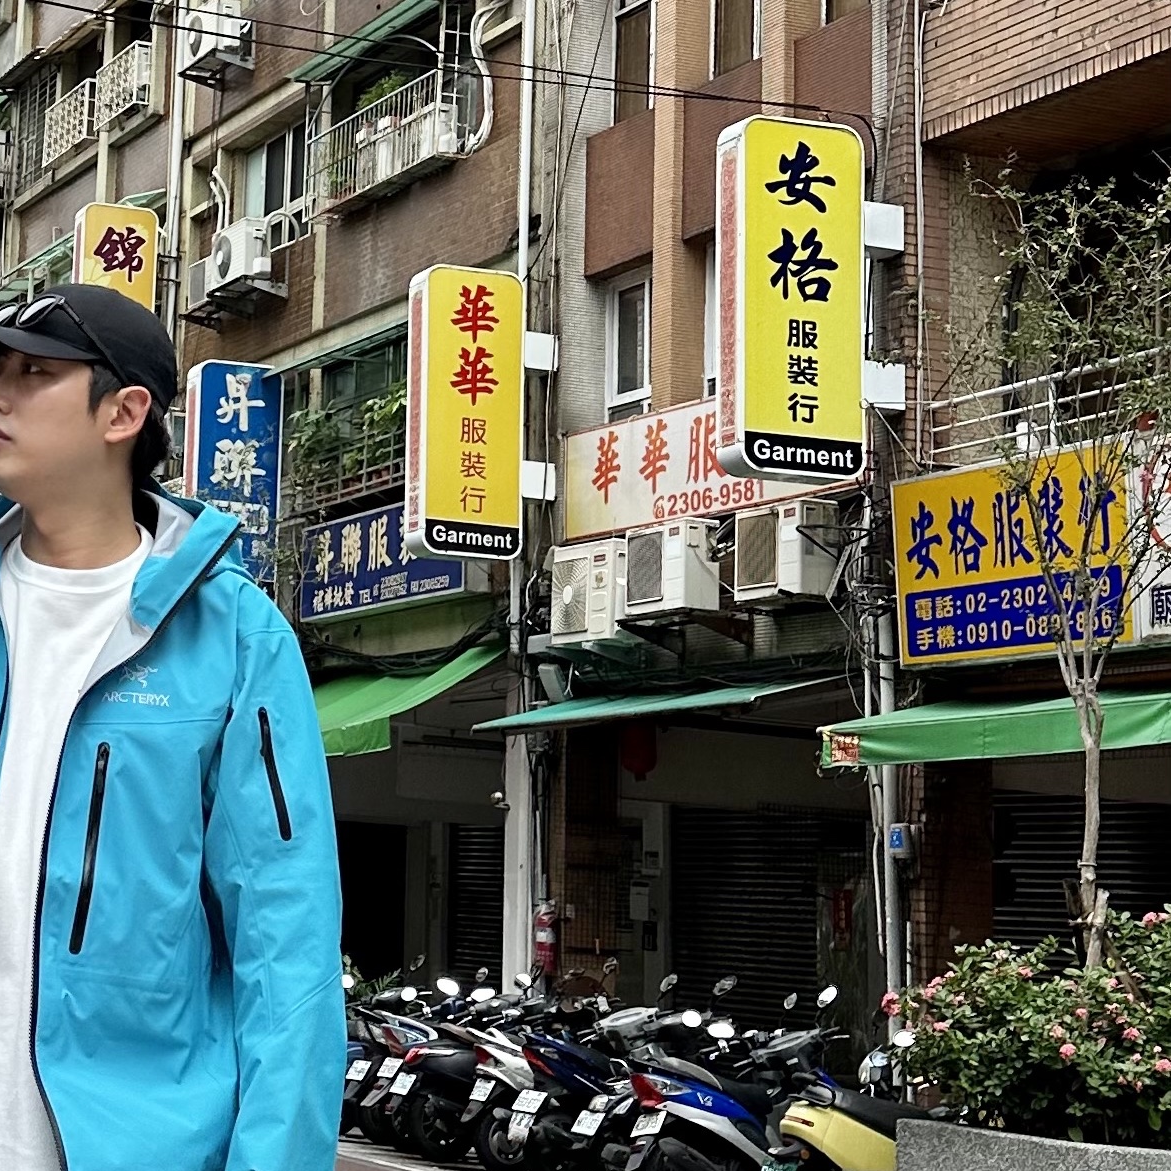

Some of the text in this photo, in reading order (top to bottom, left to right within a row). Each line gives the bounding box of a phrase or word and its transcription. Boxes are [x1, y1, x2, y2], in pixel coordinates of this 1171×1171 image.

[94, 226, 146, 282] 錦
[764, 140, 838, 303] 安格
[450, 284, 499, 406] 華華
[786, 318, 819, 424] 服裝行
[459, 417, 487, 514] 服裝行
[666, 478, 765, 518] 2306-9581
[753, 439, 854, 469] Garment
[432, 525, 512, 550] Garment
[906, 475, 1116, 580] 安格服裝行
